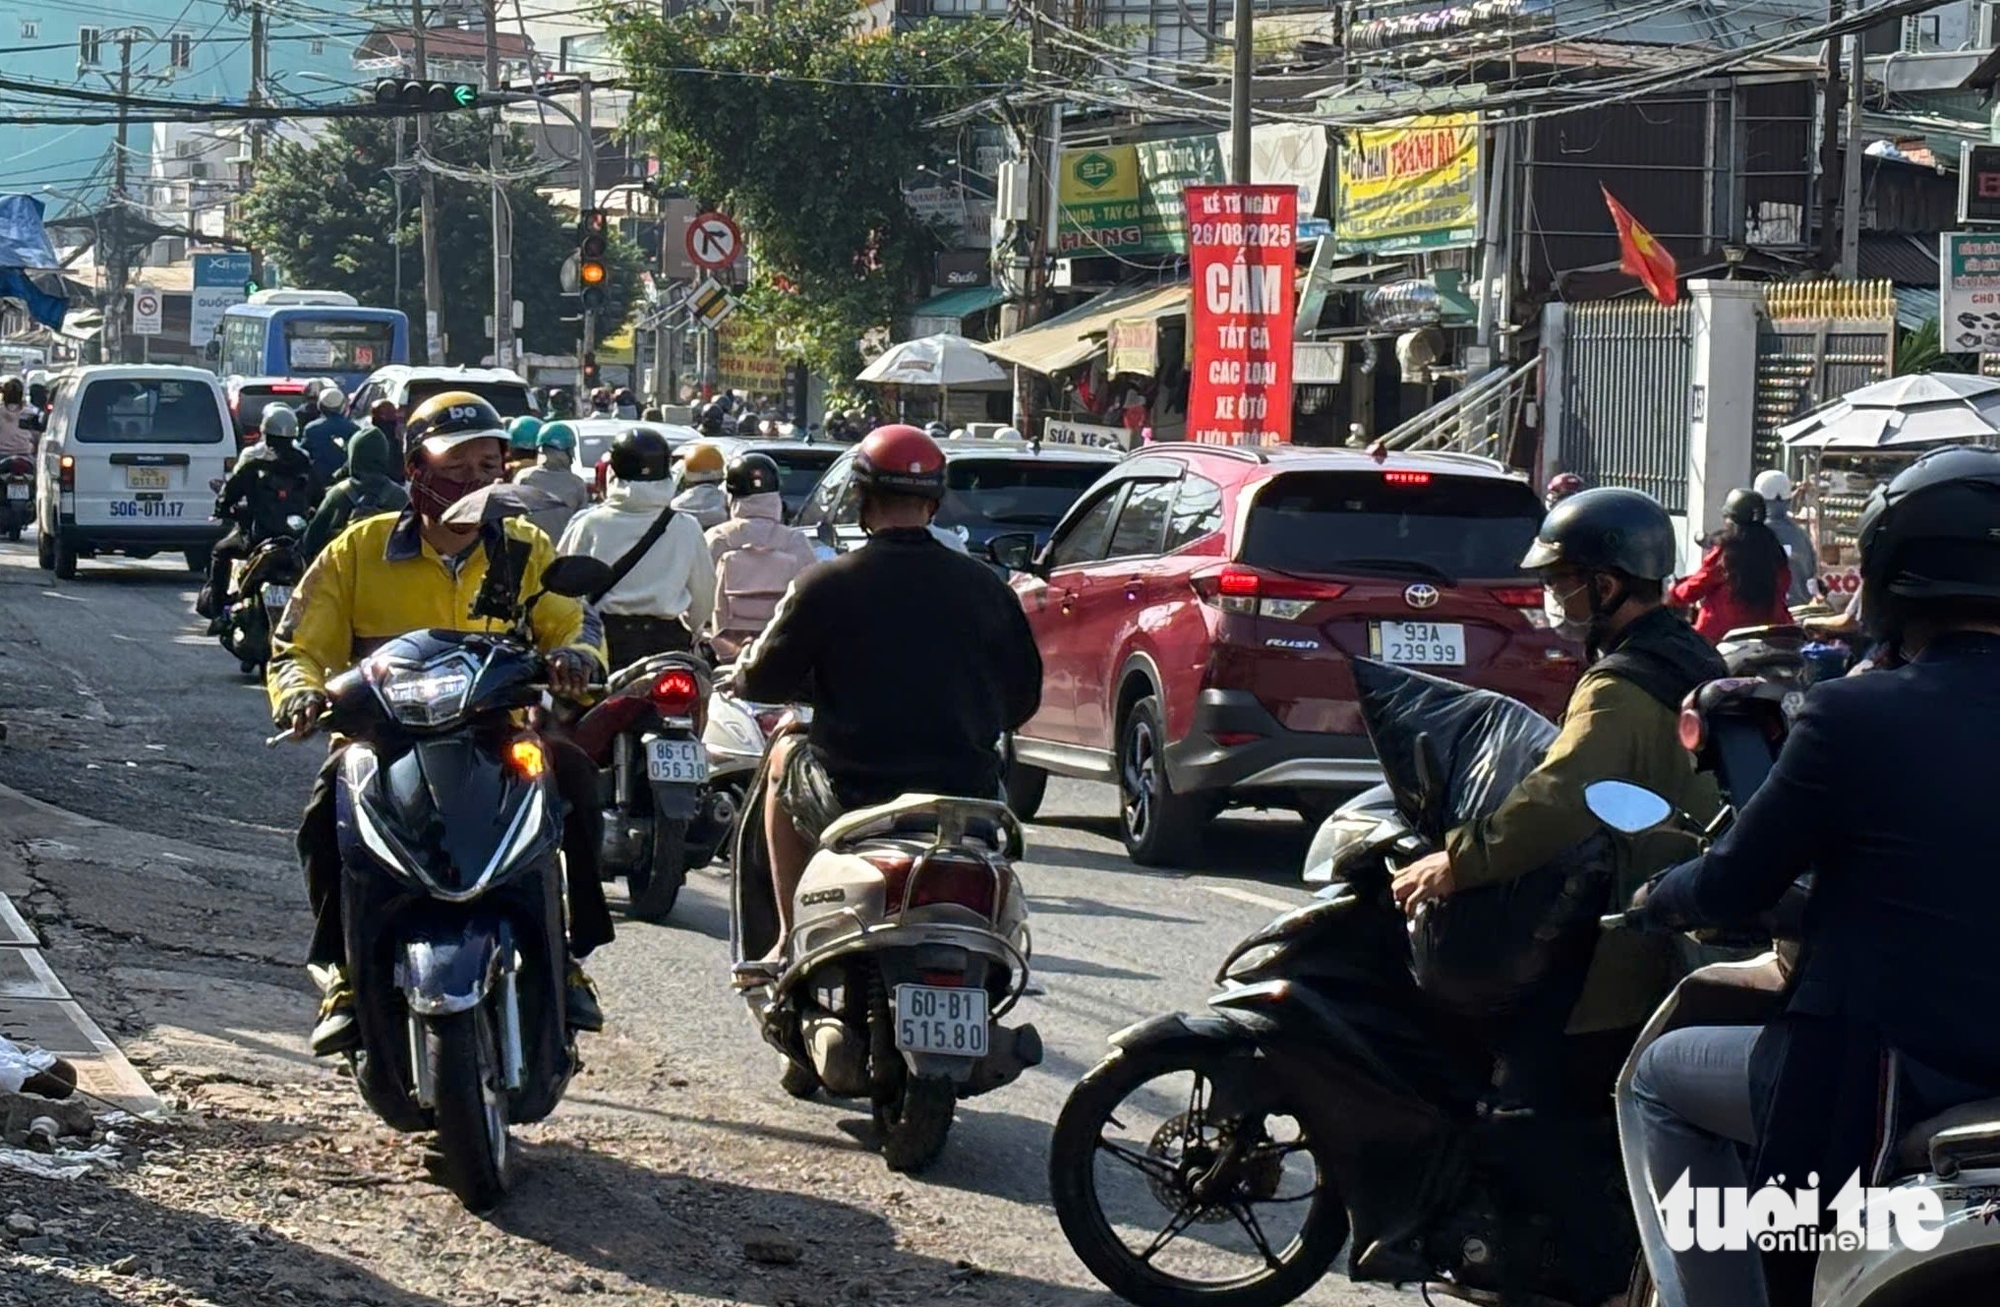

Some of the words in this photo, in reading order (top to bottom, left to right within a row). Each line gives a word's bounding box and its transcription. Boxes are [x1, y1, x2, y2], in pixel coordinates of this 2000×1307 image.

[1192, 222, 1291, 247] 26/08/2025
[1205, 246, 1282, 315] CẤM
[1208, 357, 1240, 385] CÁC
[1215, 395, 1235, 419] XE
[110, 501, 185, 517] 50G-011.17
[1404, 623, 1440, 642] 93A
[656, 743, 698, 761] 86-C1
[911, 990, 971, 1021] 60-B1
[902, 1019, 982, 1050] 515.80
